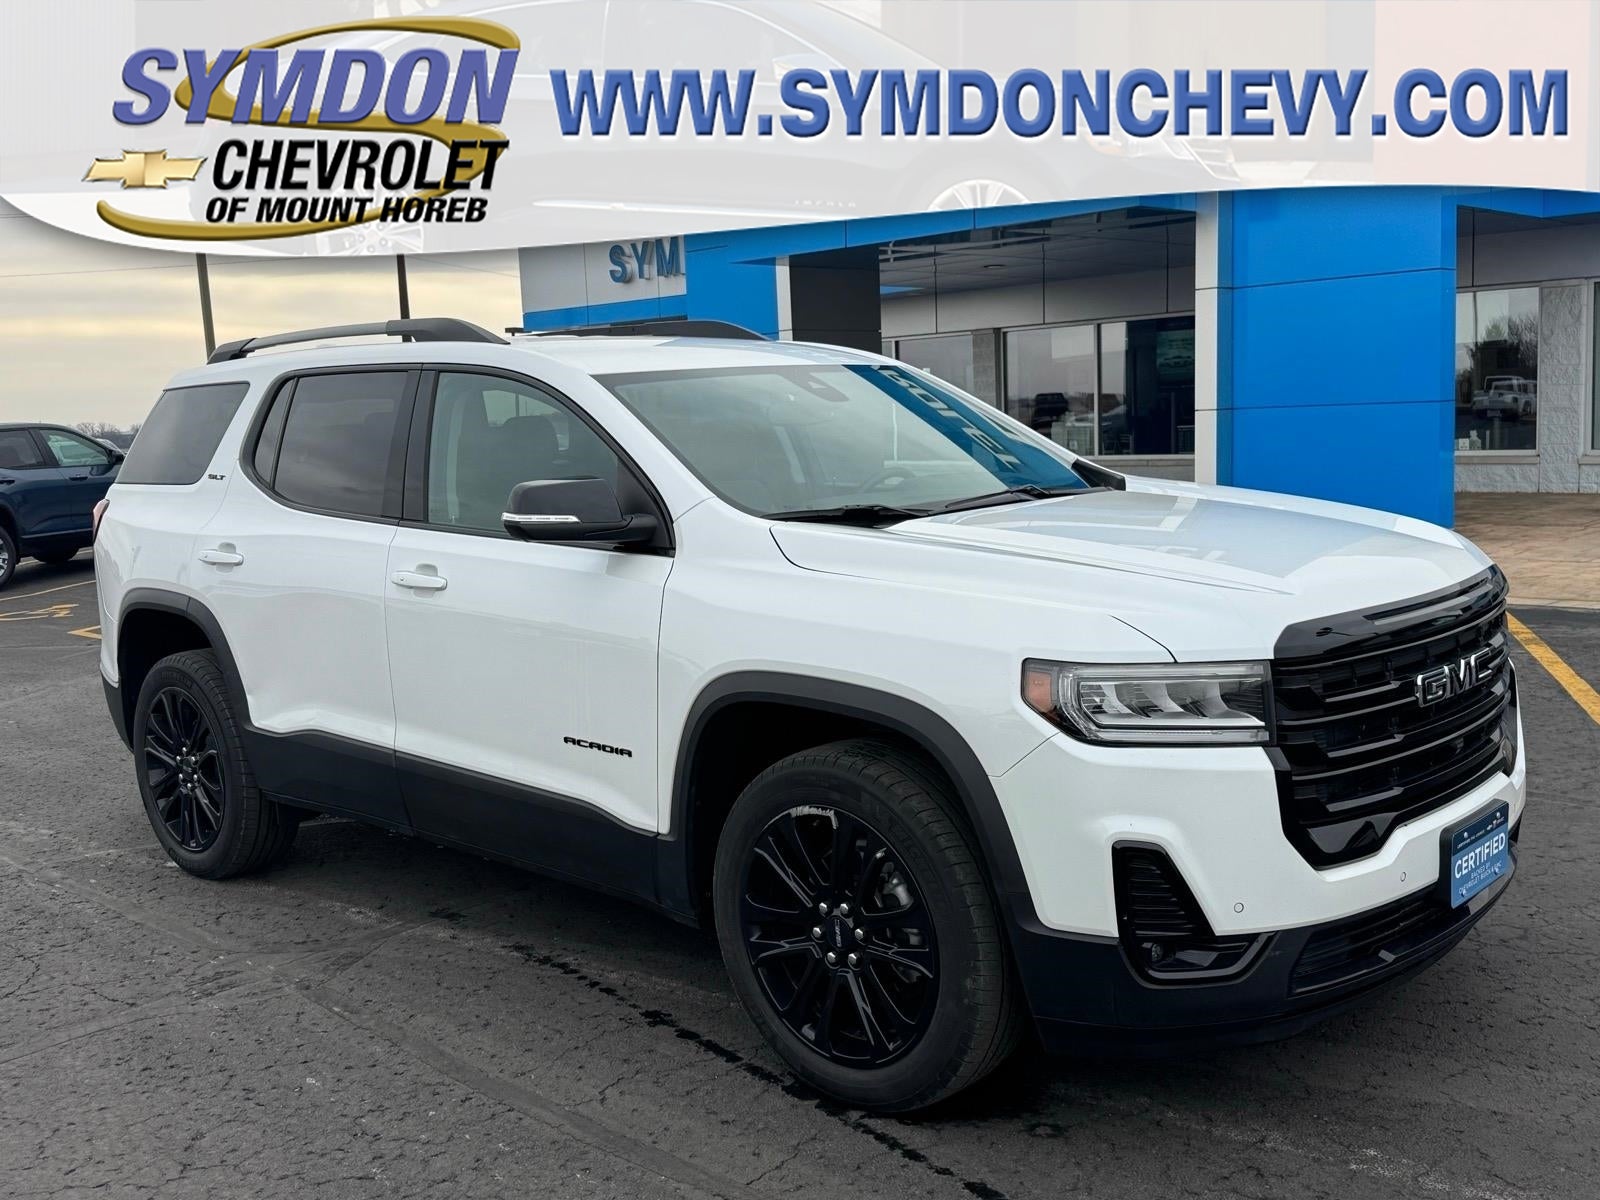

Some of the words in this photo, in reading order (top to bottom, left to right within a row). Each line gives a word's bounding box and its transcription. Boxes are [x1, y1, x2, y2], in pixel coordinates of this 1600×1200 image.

[208, 473, 226, 481] SLT
[1415, 647, 1493, 708] GMC
[563, 736, 633, 758] ACADIA
[1454, 832, 1506, 879] CERTIFIED
